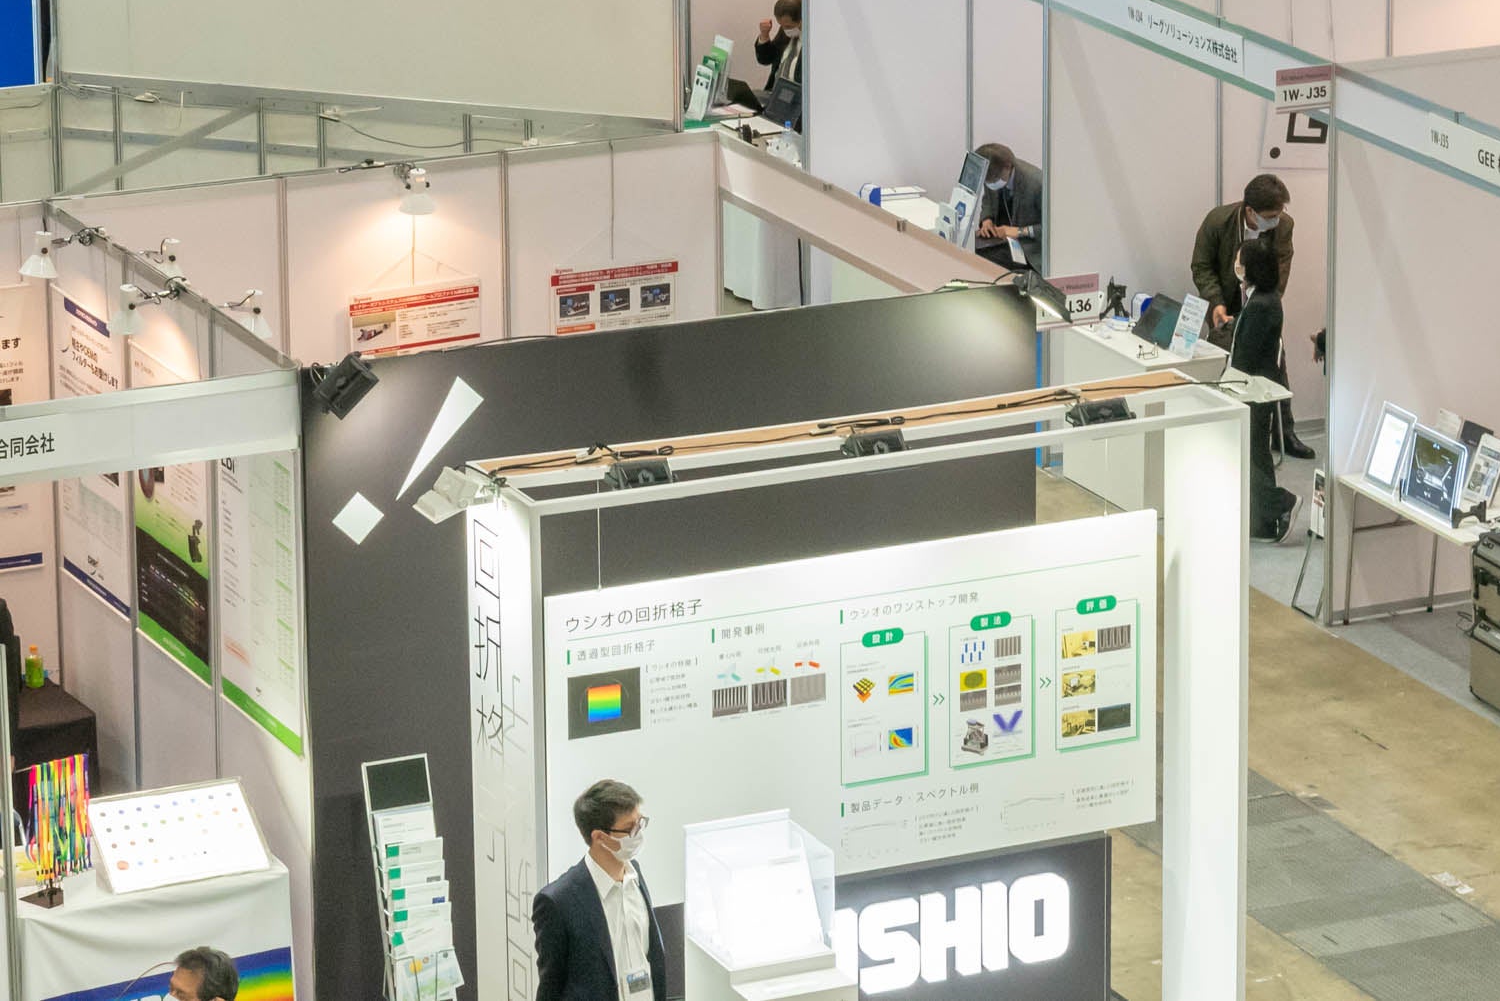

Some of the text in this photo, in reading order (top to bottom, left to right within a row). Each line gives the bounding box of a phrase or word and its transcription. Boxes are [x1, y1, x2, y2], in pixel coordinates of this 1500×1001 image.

[1477, 148, 1496, 170] GEE
[565, 598, 703, 634] ウシオの回折格子
[849, 592, 980, 621] ウシオのワンストップ開発
[721, 623, 766, 640] 開発事例
[871, 631, 894, 645] 設計
[577, 639, 656, 662] 透過型回折格子
[850, 782, 980, 814] 製品データ・スペクトル例
